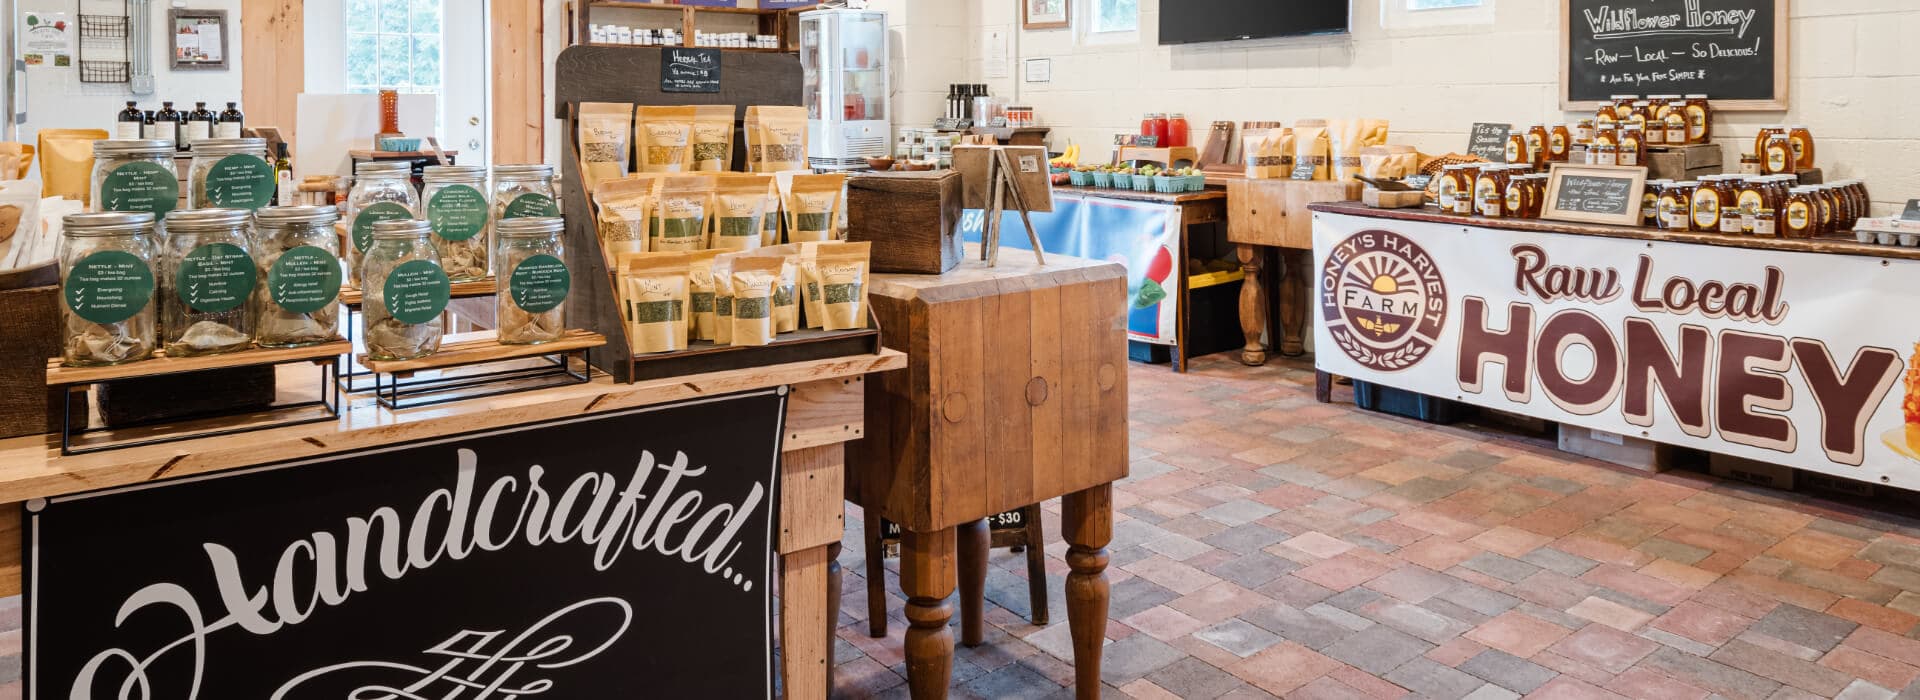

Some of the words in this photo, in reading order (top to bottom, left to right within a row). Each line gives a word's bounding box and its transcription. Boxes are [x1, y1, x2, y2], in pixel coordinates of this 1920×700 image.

[1584, 6, 1680, 33] Wildflower
[1685, 0, 1756, 38] Honey
[1323, 234, 1376, 307] HONEY'S
[1383, 234, 1444, 327] HARVEST
[1344, 290, 1418, 316] FARM
[1510, 243, 1624, 303] Raw
[1631, 254, 1790, 326] Local
[1456, 295, 1904, 466] HONEY
[998, 512, 1020, 526] $30
